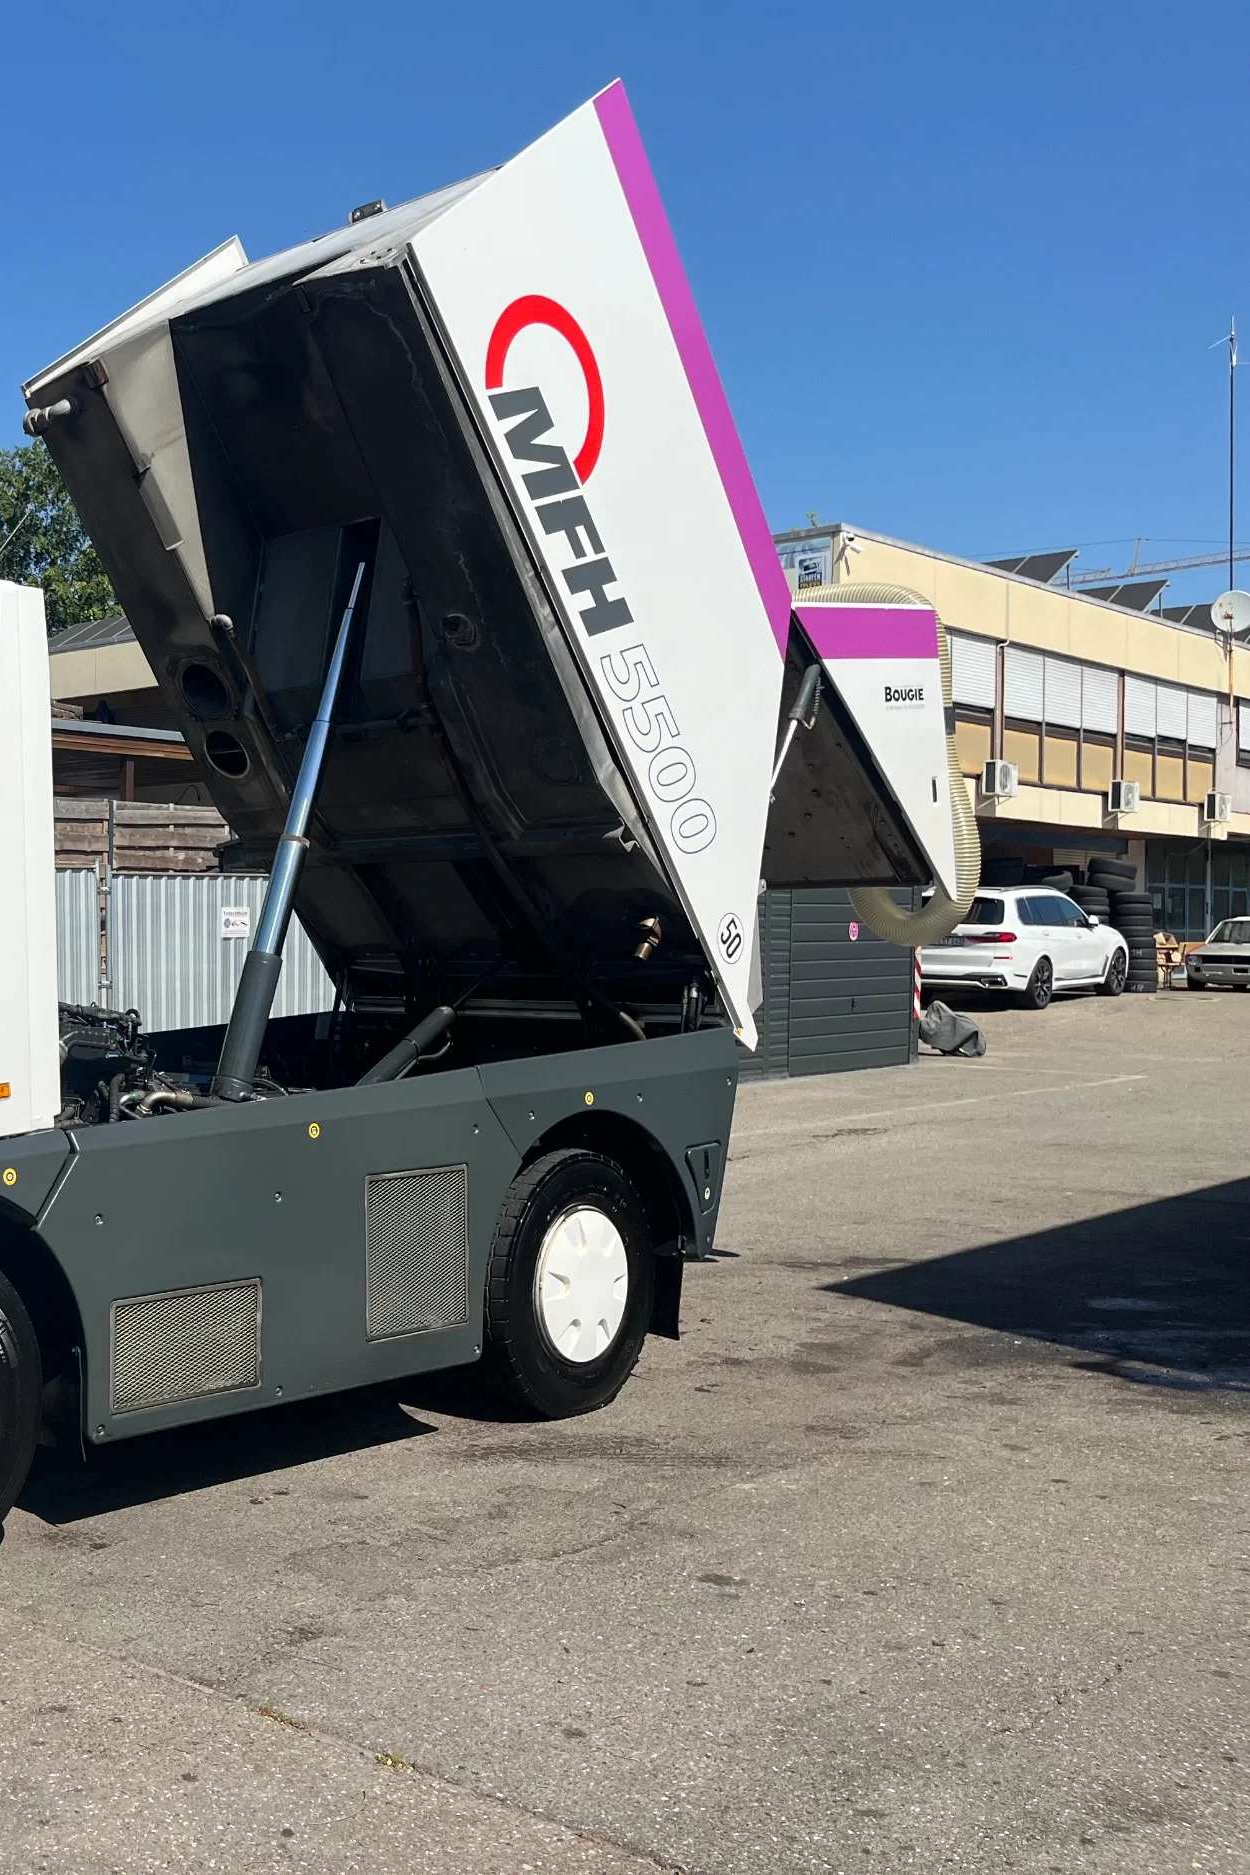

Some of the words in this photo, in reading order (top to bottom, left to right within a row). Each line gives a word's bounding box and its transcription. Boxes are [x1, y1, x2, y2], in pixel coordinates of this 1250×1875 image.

[487, 386, 635, 638] MFH
[599, 643, 718, 856] 5500
[884, 686, 925, 703] BOUGIE
[720, 917, 742, 959] 50
